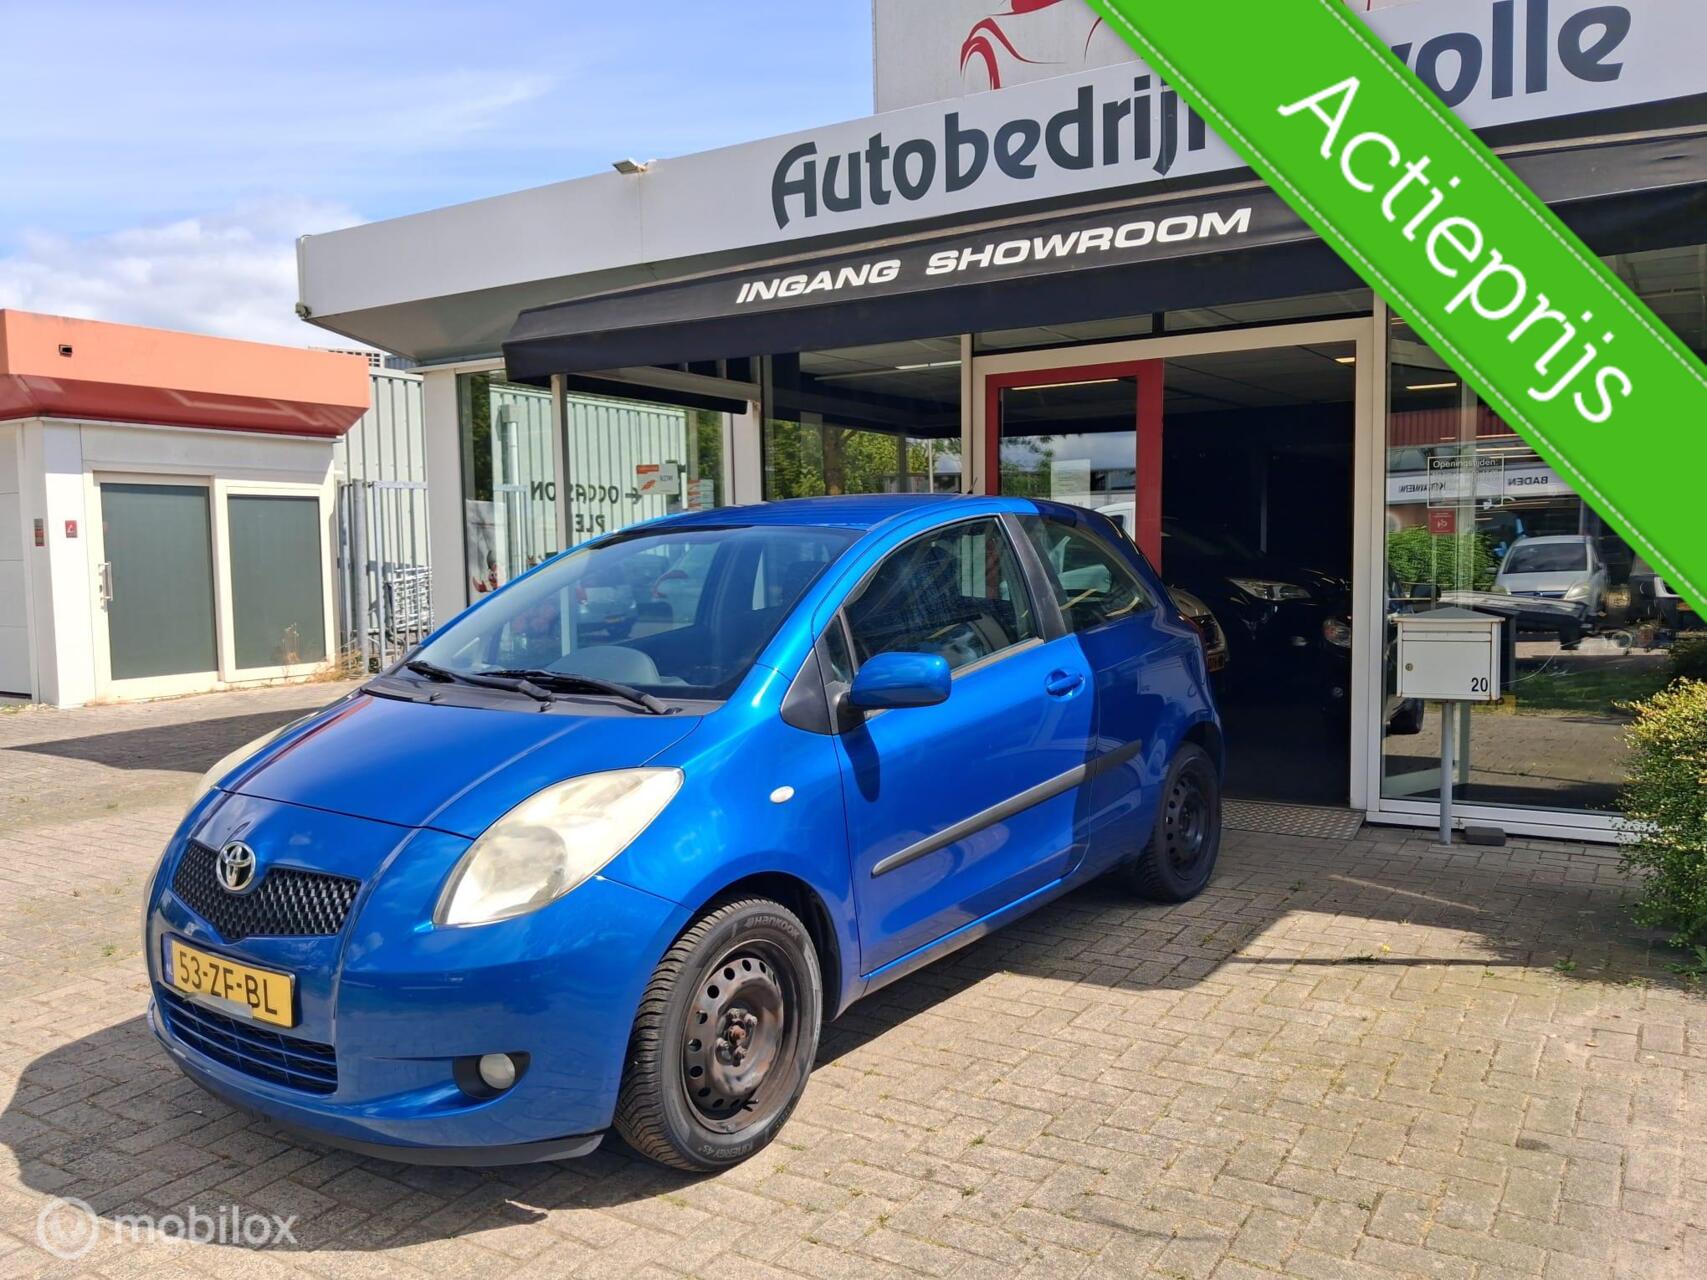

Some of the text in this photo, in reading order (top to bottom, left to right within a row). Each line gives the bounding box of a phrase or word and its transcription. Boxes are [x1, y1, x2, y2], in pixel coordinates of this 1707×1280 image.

[1391, 0, 1632, 108] olle
[736, 208, 1252, 304] INGANG SHOWROOM
[1471, 677, 1488, 692] 20
[179, 951, 278, 1016] 53-ZF-BL
